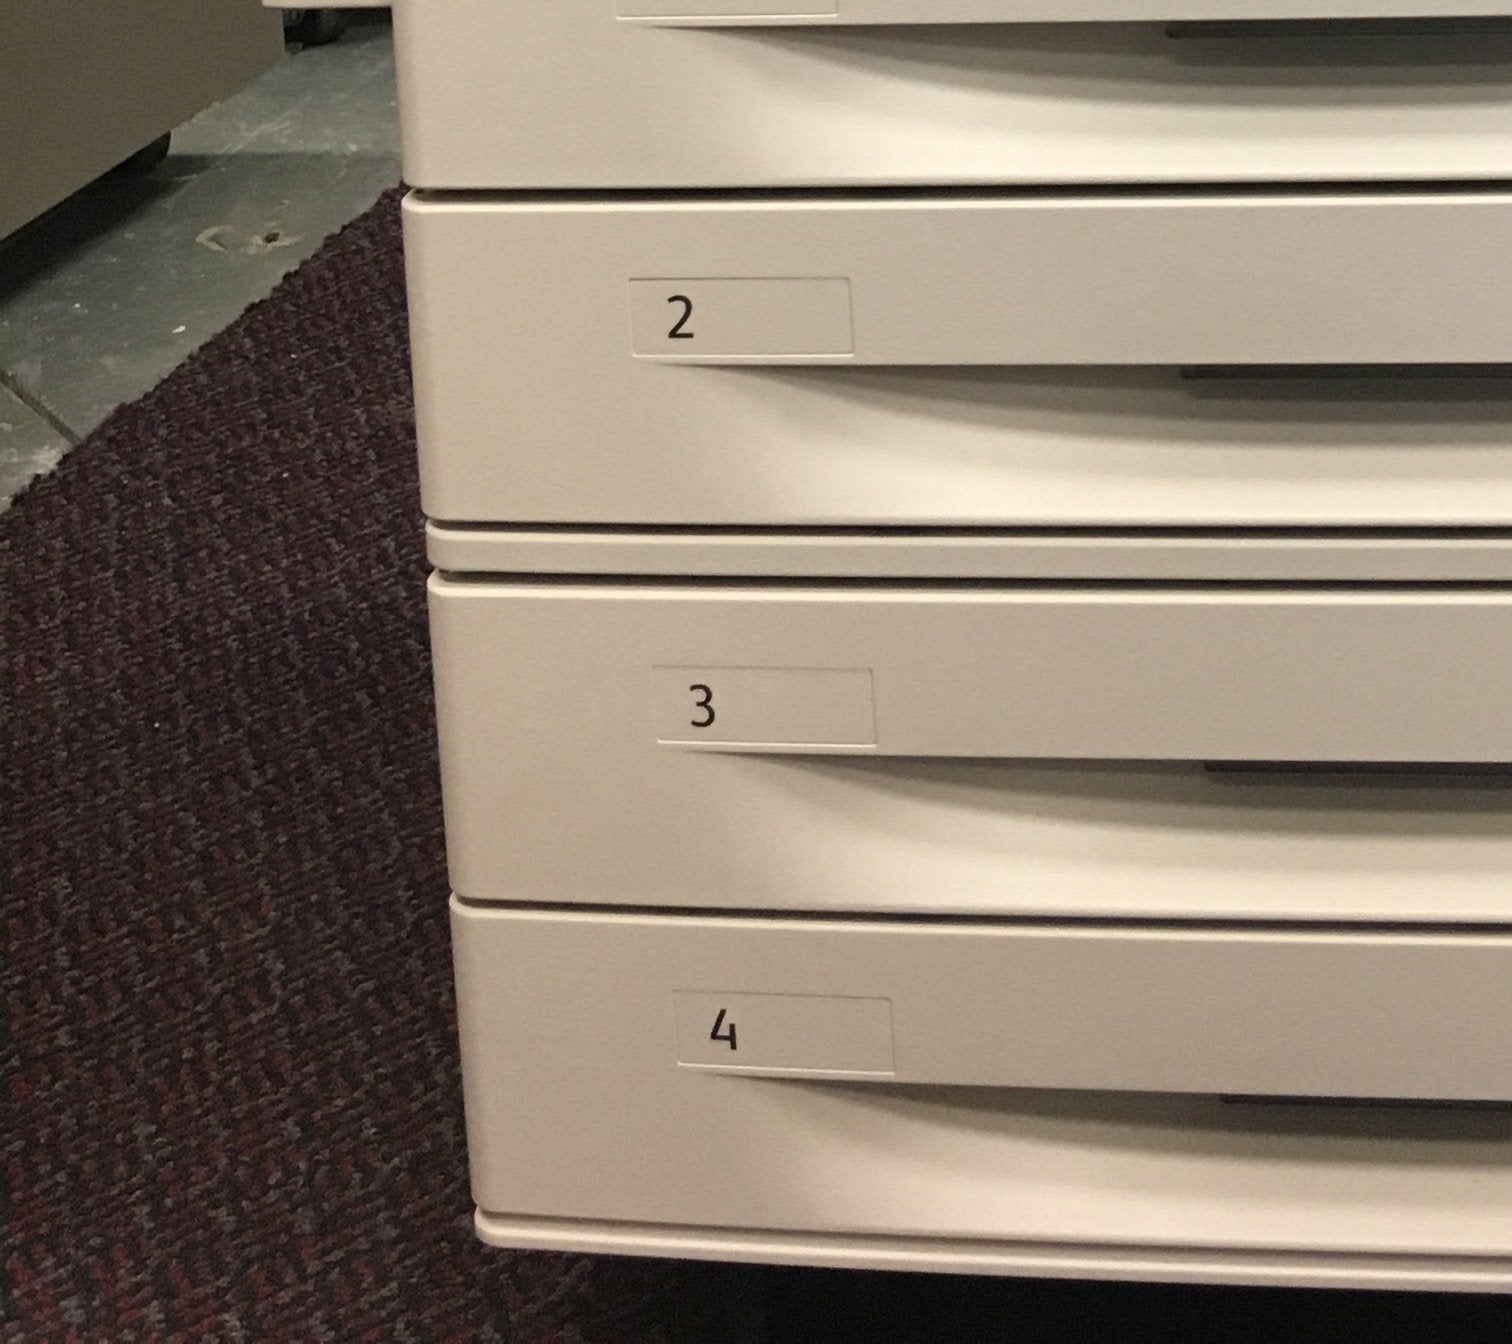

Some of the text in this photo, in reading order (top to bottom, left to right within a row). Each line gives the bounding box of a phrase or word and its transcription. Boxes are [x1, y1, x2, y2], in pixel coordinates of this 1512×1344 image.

[667, 294, 694, 339] 2
[689, 684, 715, 728] 3
[710, 1008, 737, 1050] 4
